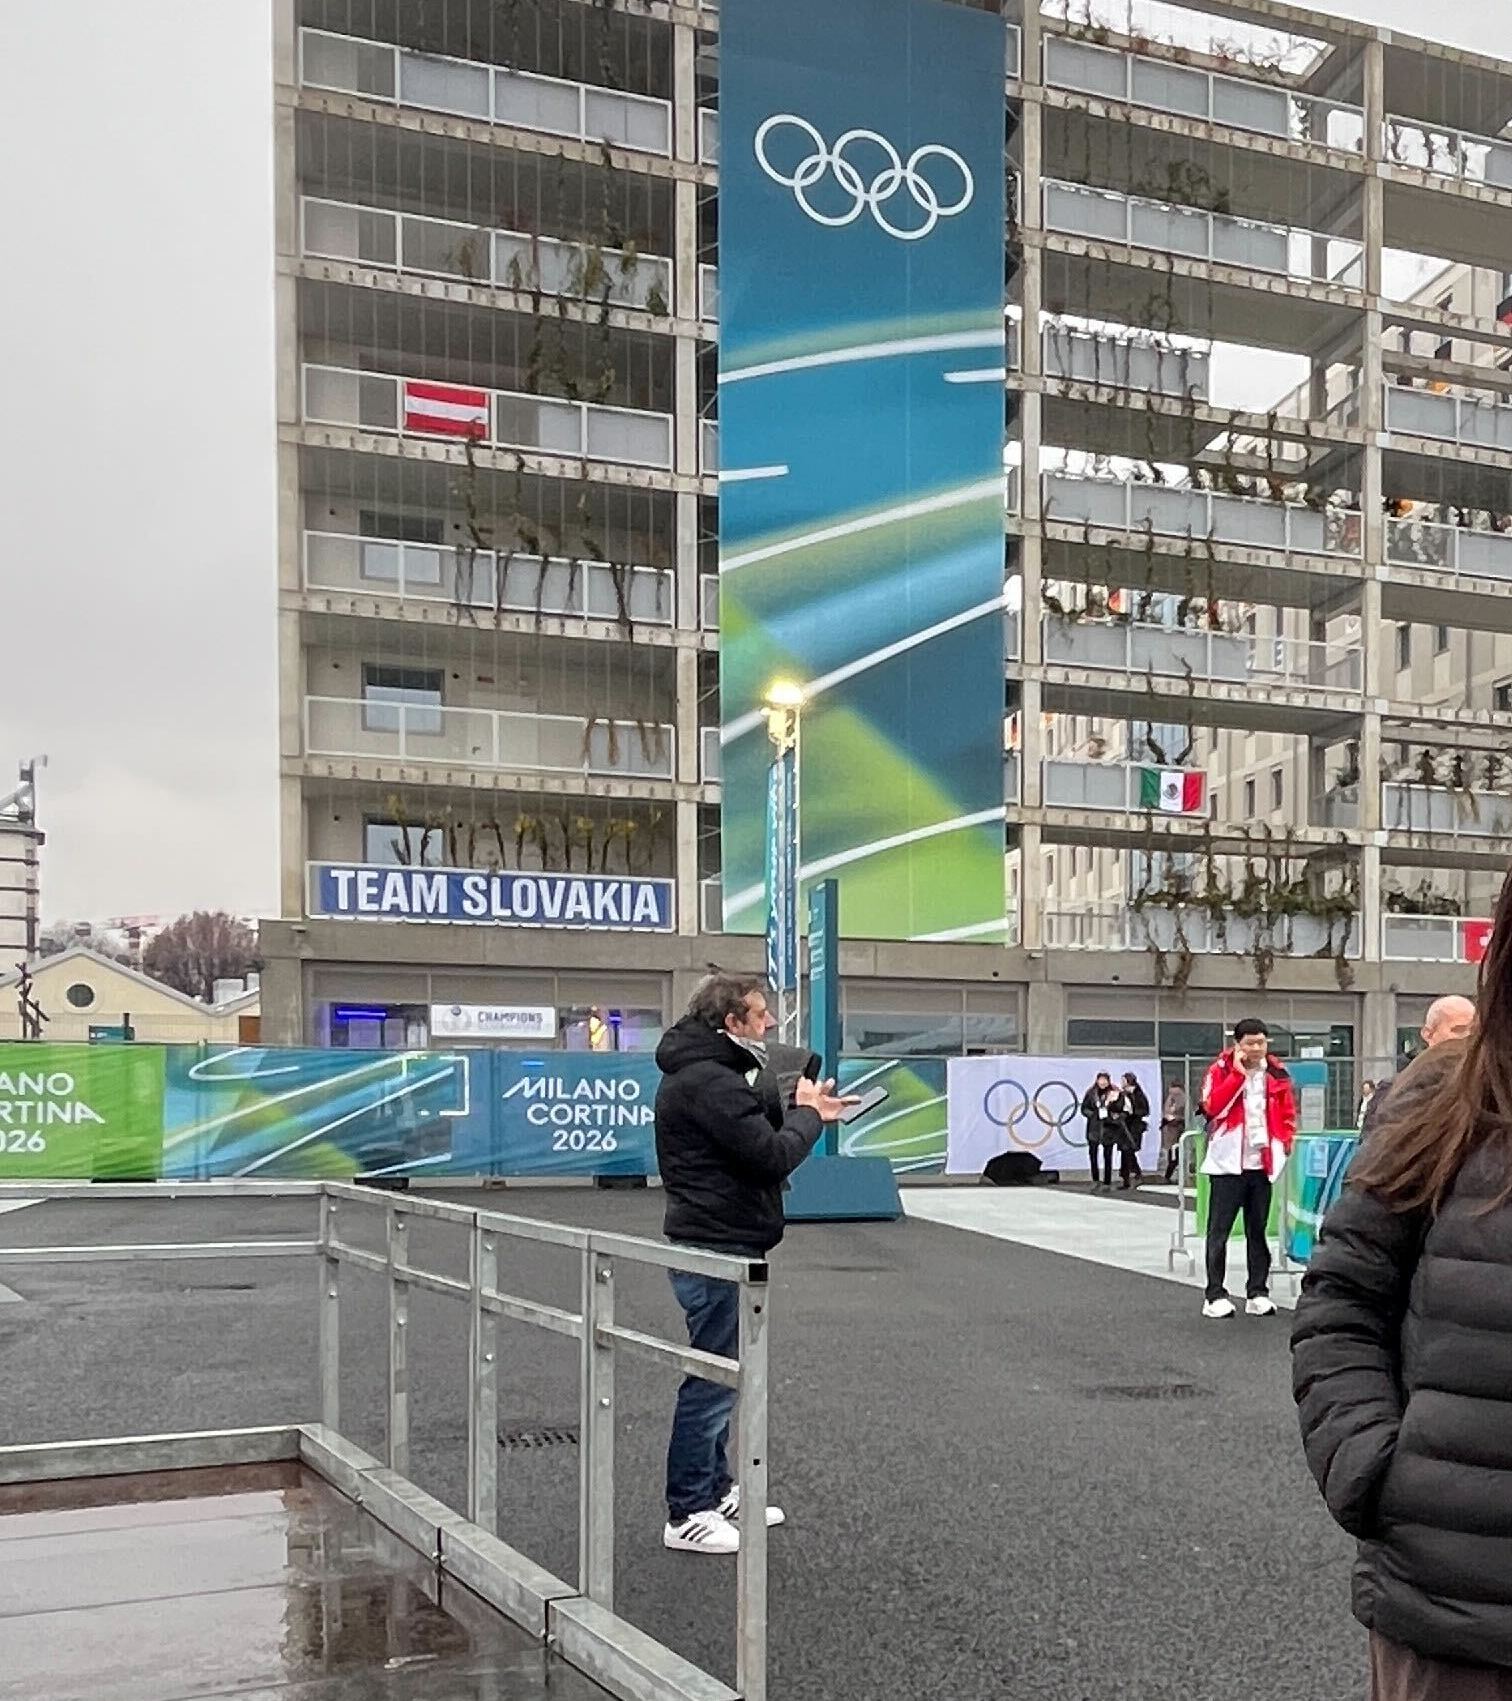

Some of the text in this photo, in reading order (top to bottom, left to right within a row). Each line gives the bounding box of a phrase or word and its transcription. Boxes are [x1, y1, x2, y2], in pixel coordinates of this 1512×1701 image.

[330, 869, 660, 923] TEAM SLOVAKIA
[478, 1010, 544, 1024] CHAMPIONS
[0, 1071, 75, 1096] ANO
[502, 1076, 640, 1101] MILANO
[0, 1100, 106, 1124] RTINA
[526, 1102, 655, 1126] CORTINA
[552, 1129, 618, 1152] 2026
